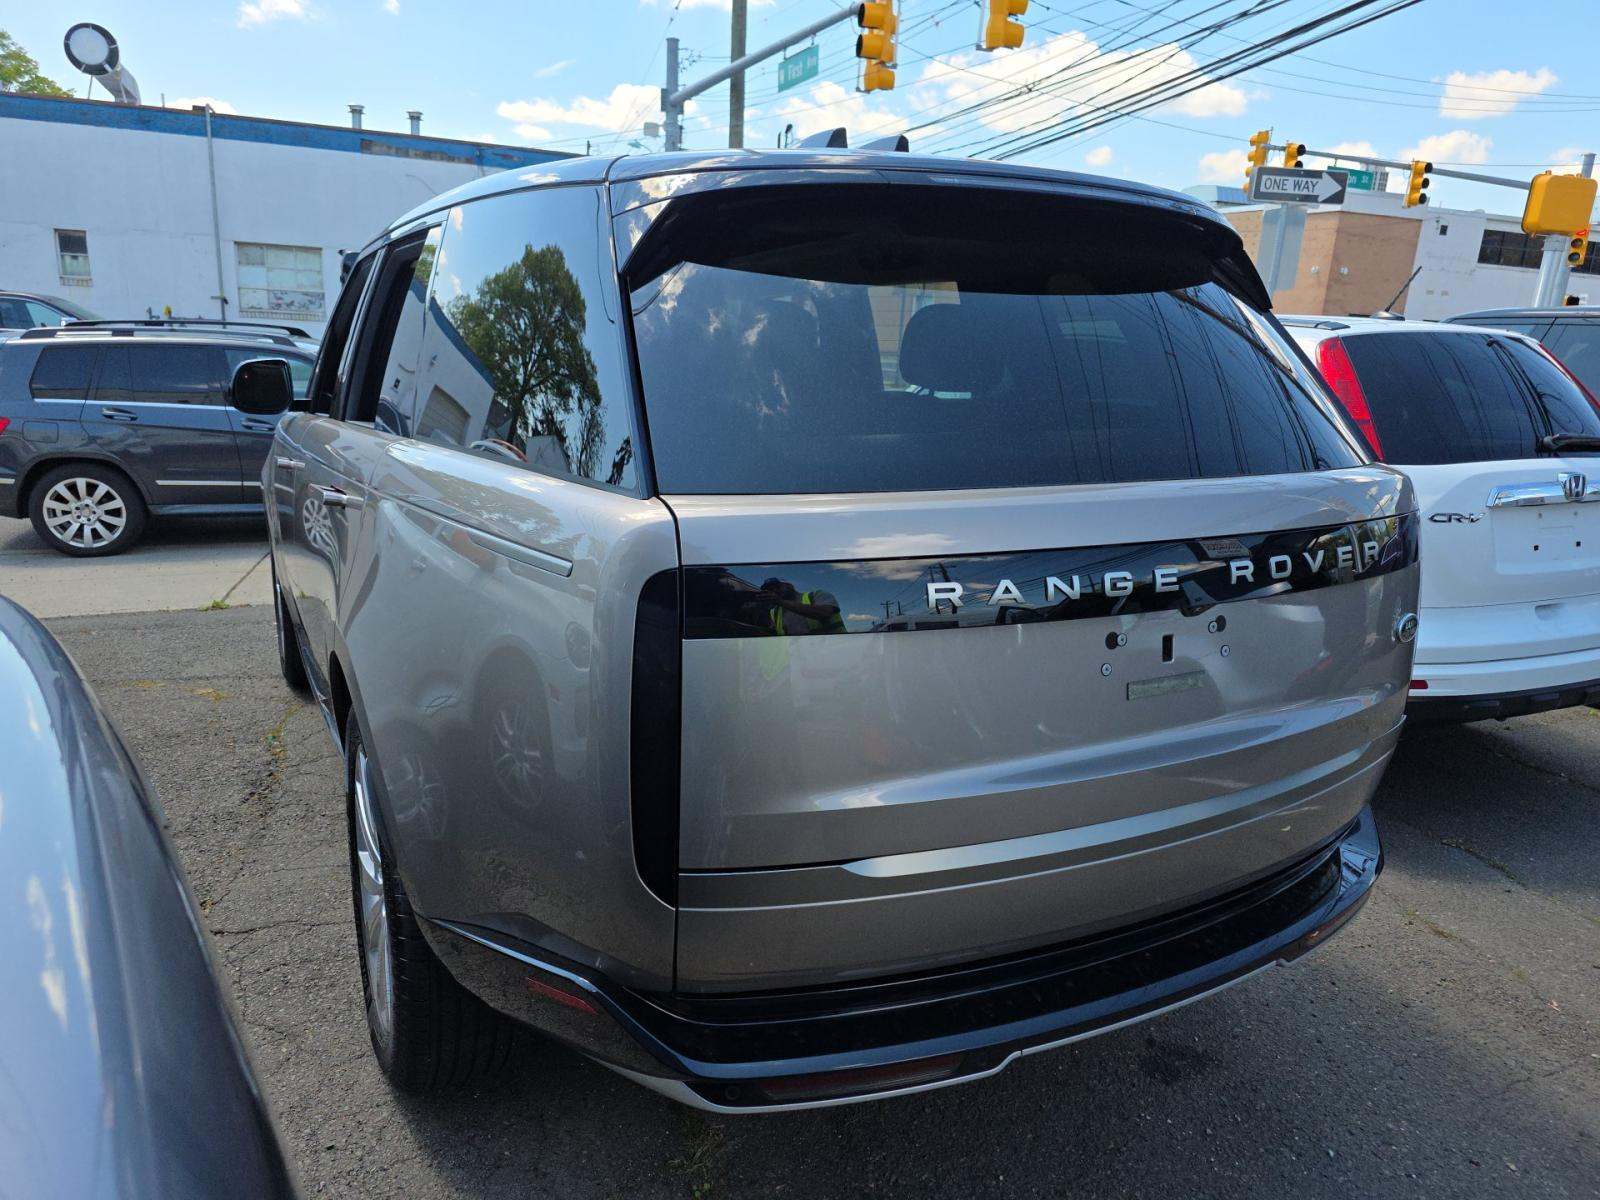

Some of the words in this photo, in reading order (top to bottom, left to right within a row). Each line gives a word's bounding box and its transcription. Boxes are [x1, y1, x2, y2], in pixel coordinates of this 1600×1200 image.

[1264, 177, 1290, 191] ONE
[1293, 179, 1320, 193] WAY
[927, 567, 1180, 609] RANGE
[1229, 541, 1380, 585] ROVER
